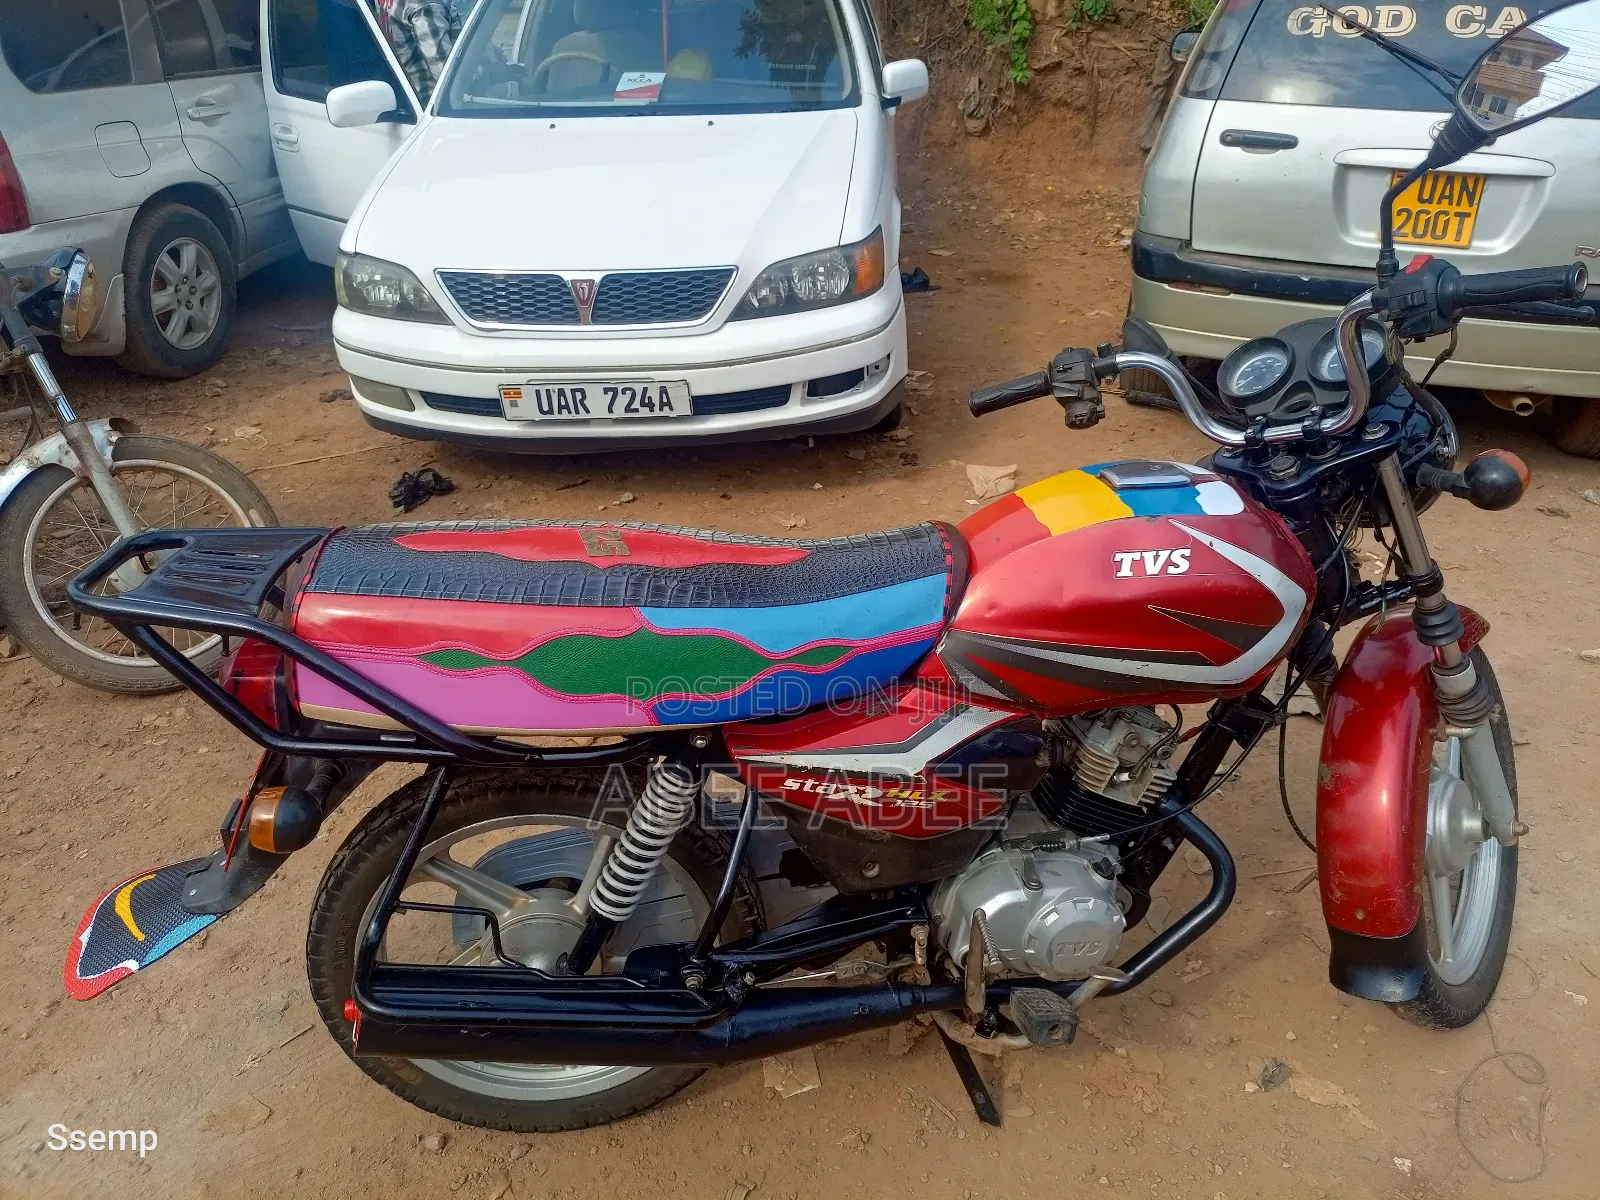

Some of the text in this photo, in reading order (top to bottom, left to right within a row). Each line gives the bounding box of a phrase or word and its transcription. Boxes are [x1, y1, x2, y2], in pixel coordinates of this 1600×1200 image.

[1286, 4, 1417, 39] GOD
[1417, 172, 1480, 208] UAN
[1391, 207, 1472, 242] 200T
[534, 385, 674, 416] UAR 724A
[1113, 547, 1192, 578] TVS
[885, 788, 950, 801] HLX
[1055, 940, 1103, 957] TVS
